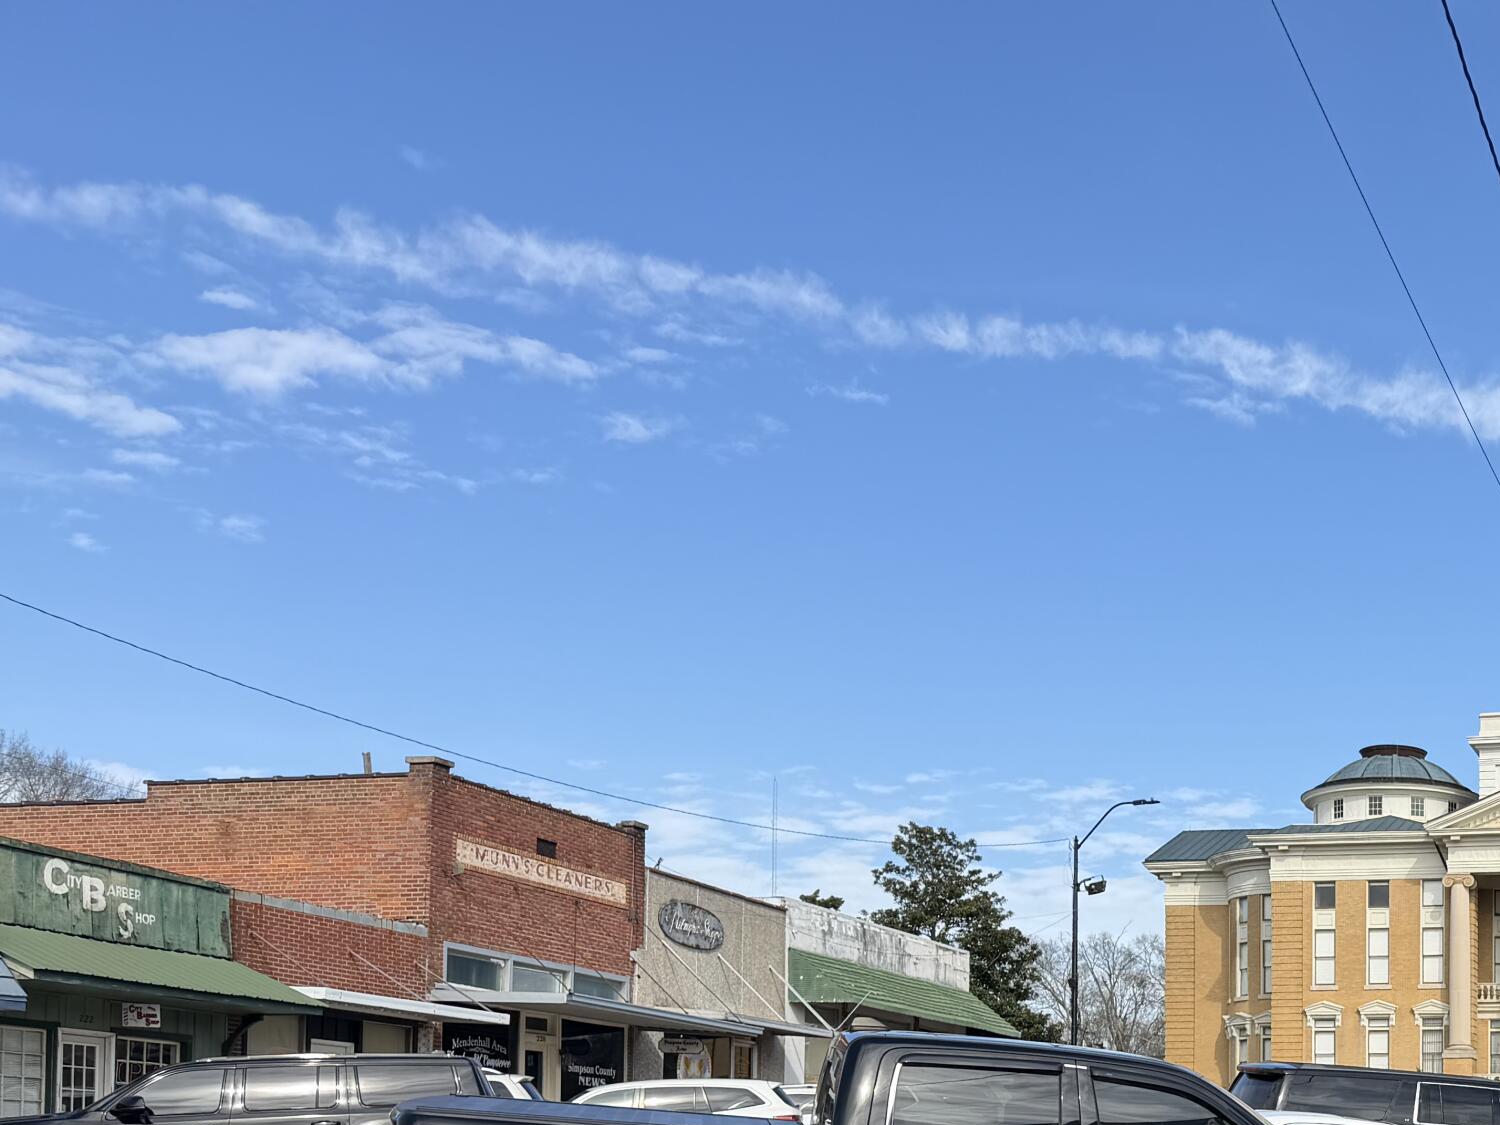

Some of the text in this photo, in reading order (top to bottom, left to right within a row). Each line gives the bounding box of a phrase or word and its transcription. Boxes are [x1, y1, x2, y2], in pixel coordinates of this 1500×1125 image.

[536, 863, 613, 895] CLEANERS
[451, 1035, 508, 1055] Mendenhall Area
[568, 1064, 616, 1079] Simpson County
[578, 1076, 607, 1087] NEWS
